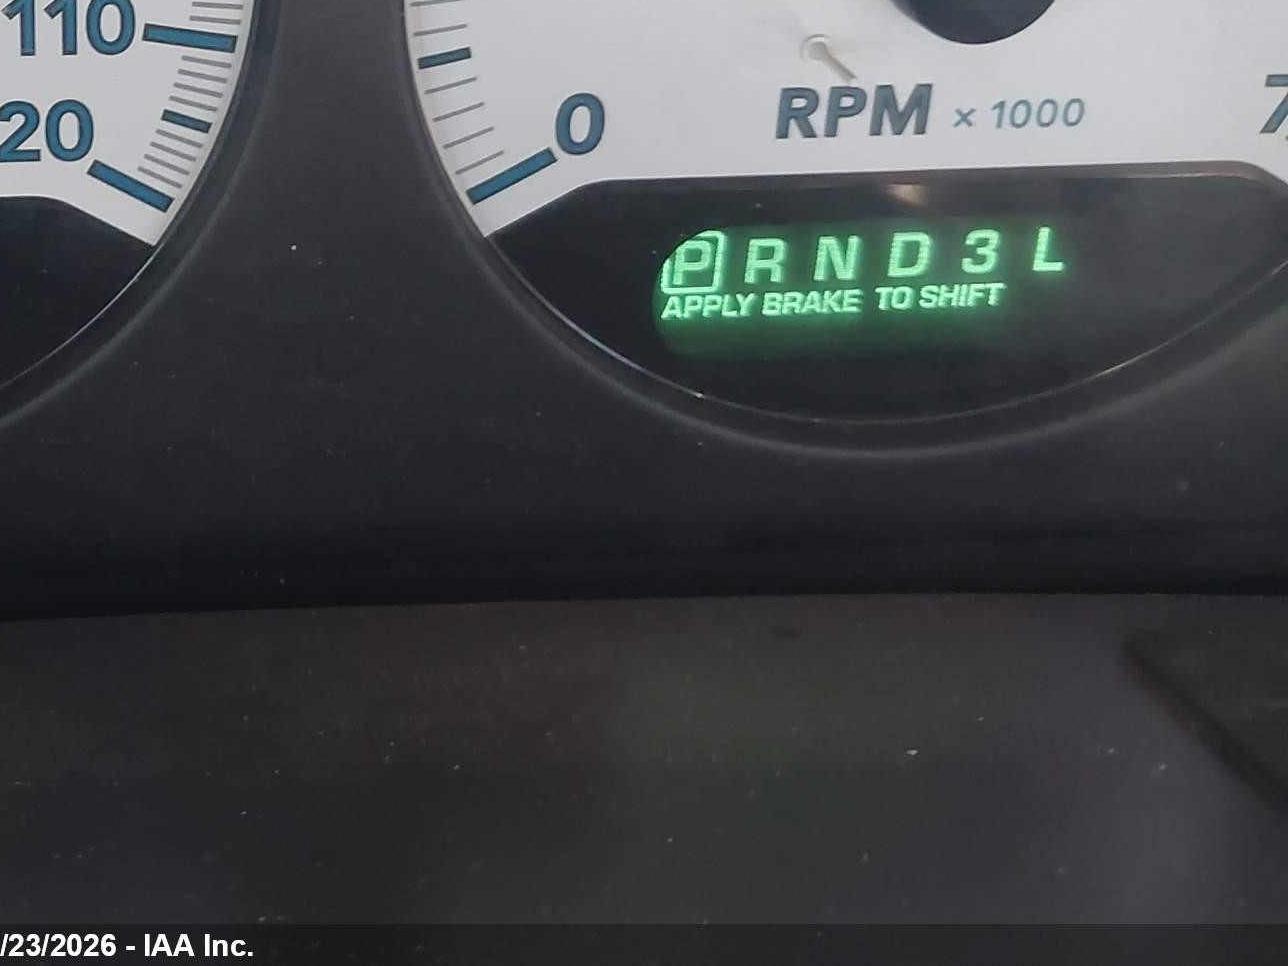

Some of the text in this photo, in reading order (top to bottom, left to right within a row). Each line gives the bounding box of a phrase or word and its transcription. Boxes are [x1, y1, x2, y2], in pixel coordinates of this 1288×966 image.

[555, 93, 605, 154] 0
[776, 84, 933, 139] RPM
[992, 98, 1084, 128] 1000
[673, 226, 1065, 286] P R N D 3 L
[661, 282, 1006, 319] APPLY BRAKE TO SHIFT
